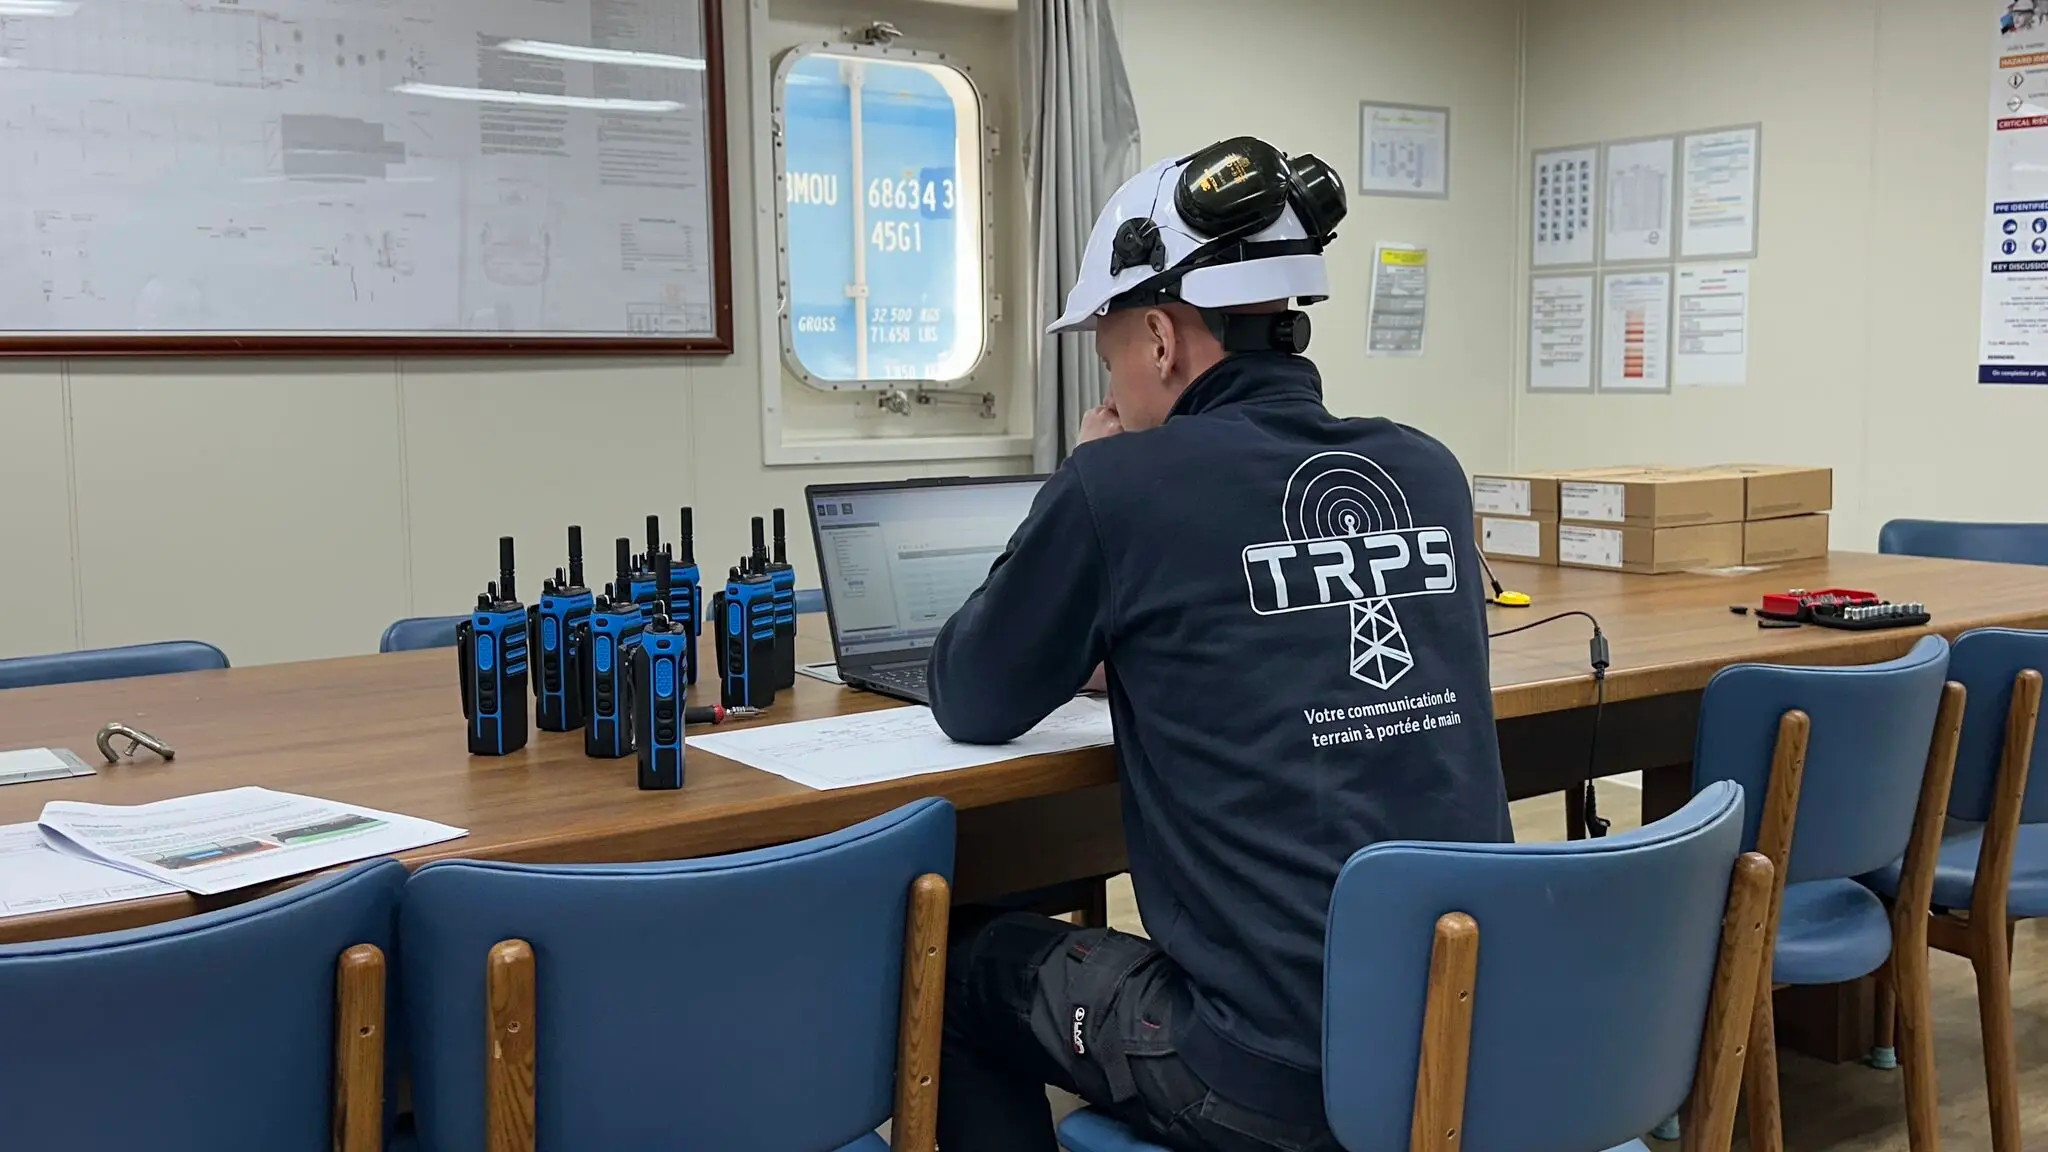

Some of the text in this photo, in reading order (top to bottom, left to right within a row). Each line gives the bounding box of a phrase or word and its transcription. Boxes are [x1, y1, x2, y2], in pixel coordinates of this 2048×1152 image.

[871, 220, 921, 252] 45G1
[799, 316, 836, 333] GROSS
[918, 326, 938, 342] LBS
[1247, 531, 1453, 608] TRPS
[1304, 688, 1457, 725] Votre communication de
[1312, 711, 1461, 747] terrain à portée de main
